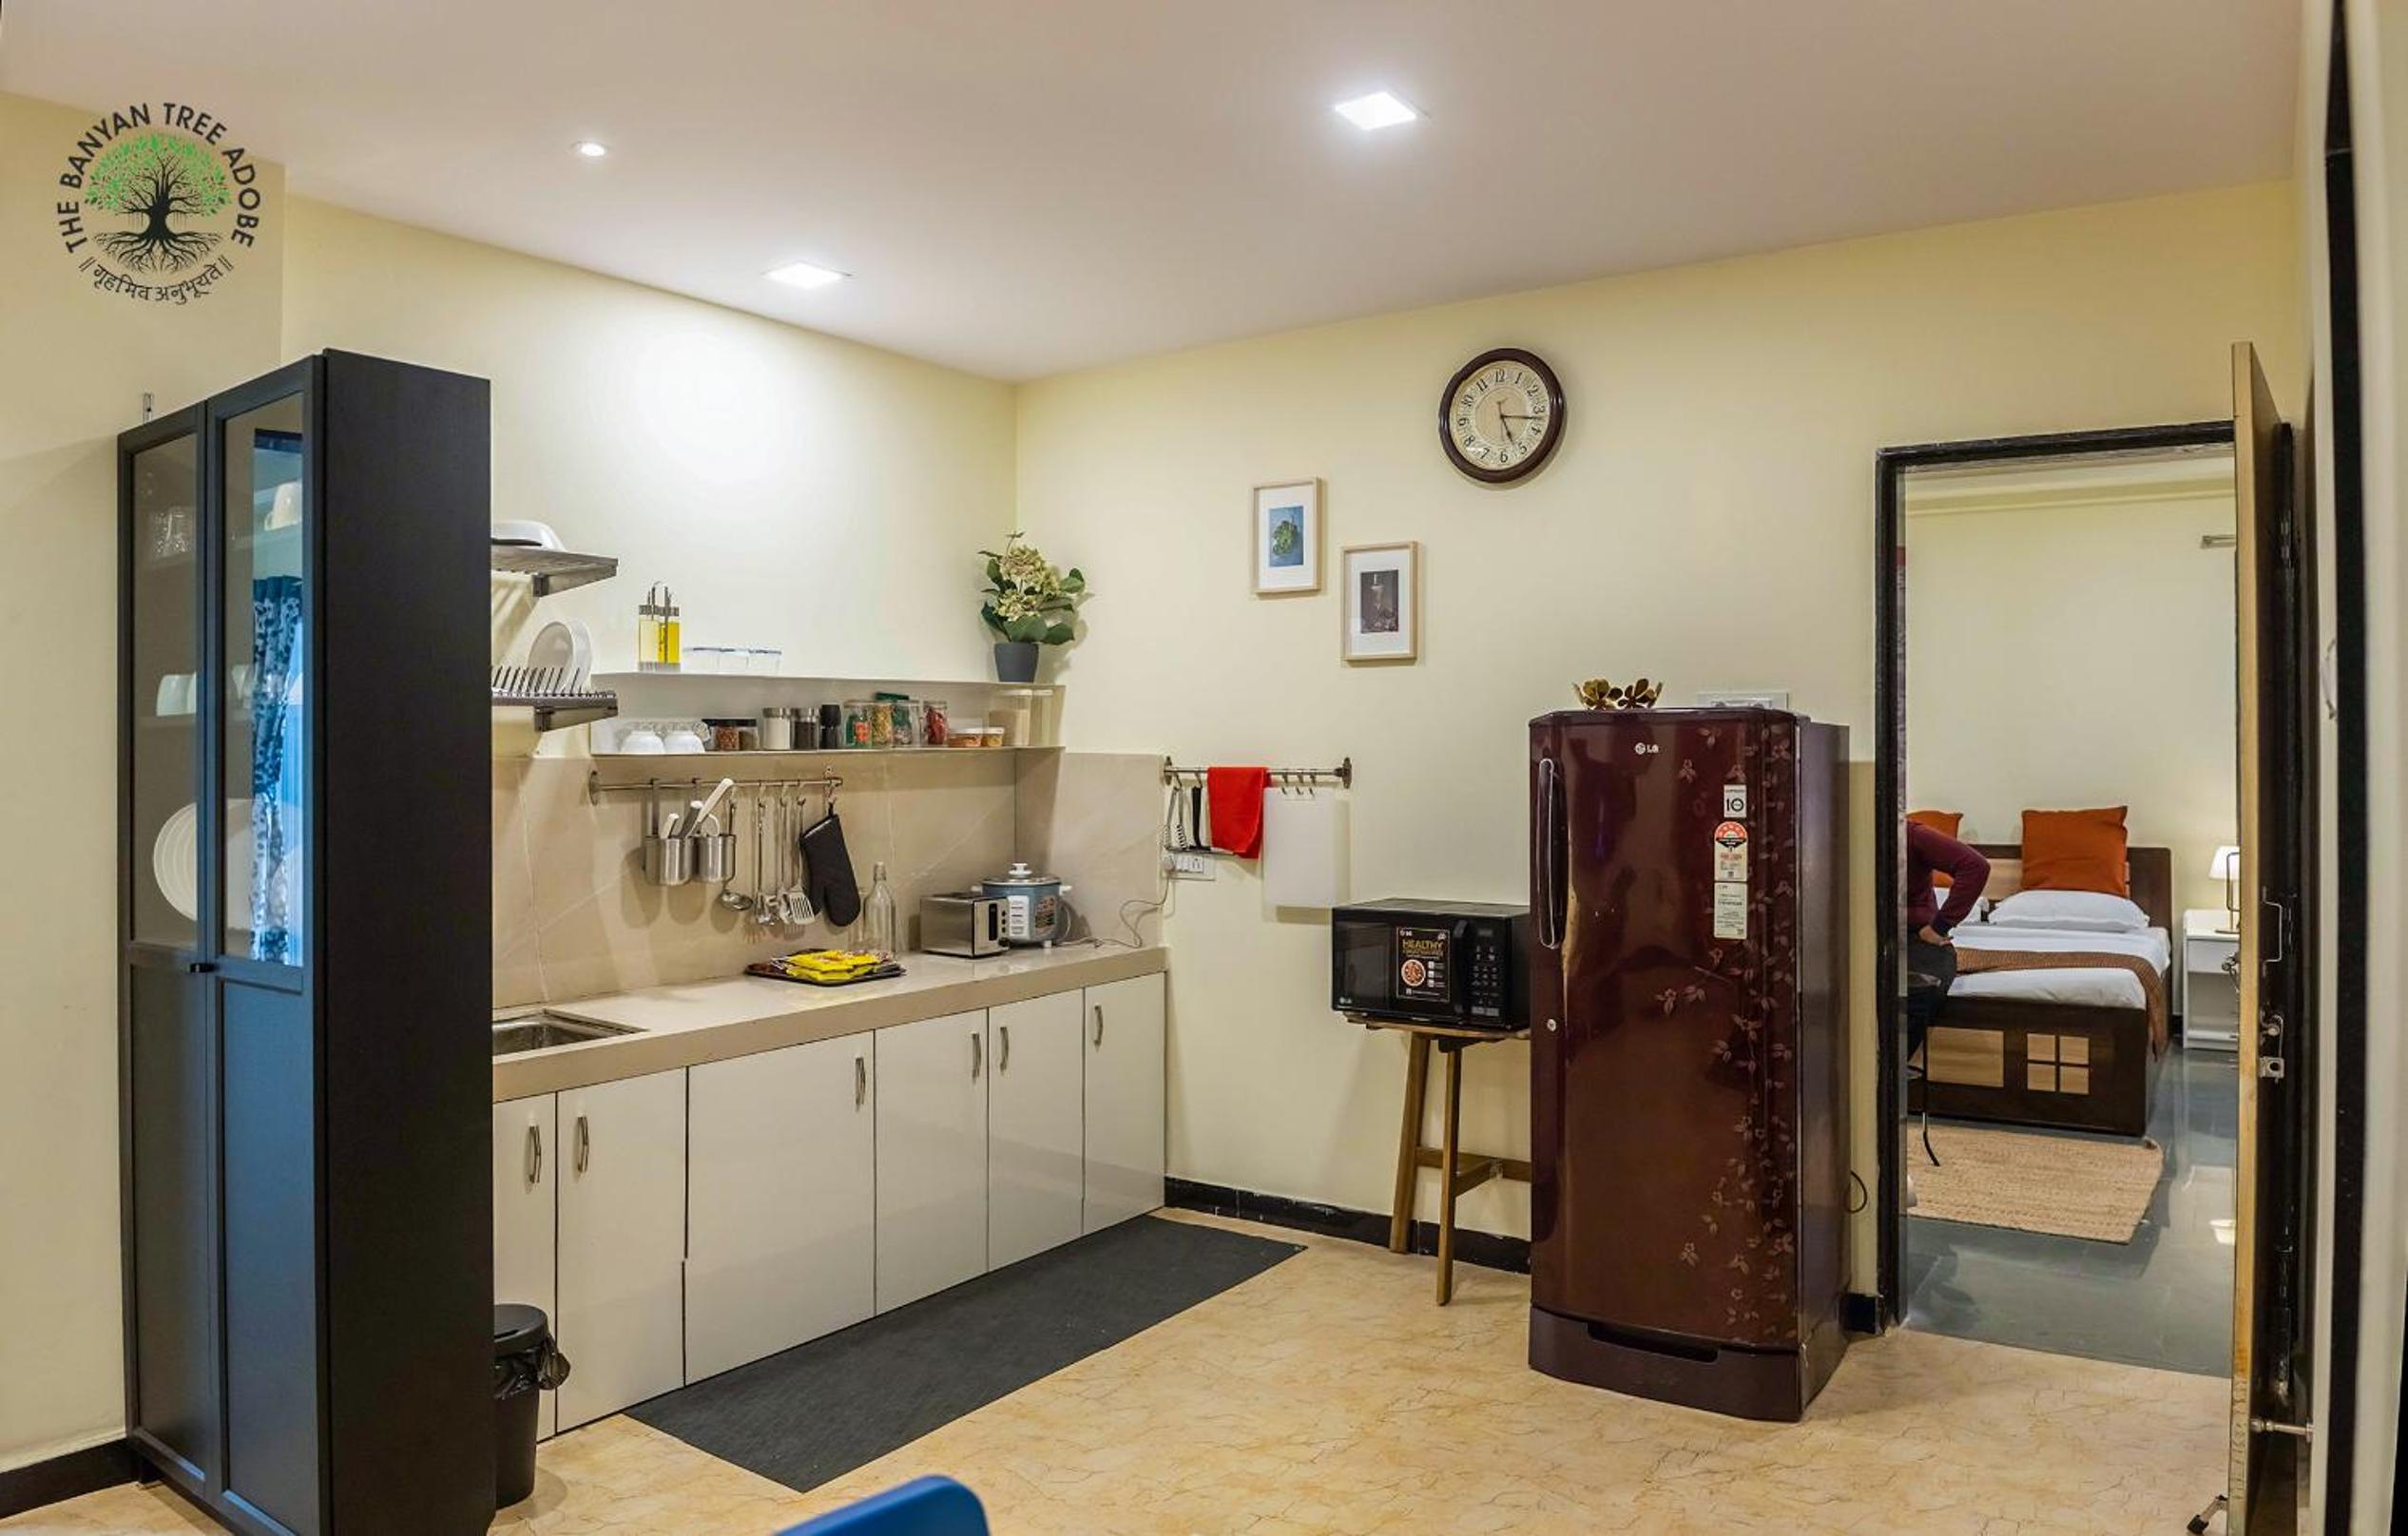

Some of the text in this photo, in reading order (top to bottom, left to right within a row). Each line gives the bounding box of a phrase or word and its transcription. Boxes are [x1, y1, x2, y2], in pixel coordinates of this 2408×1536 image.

[1494, 368, 1505, 382] 12
[1514, 372, 1522, 384] 1
[1527, 384, 1539, 396] 2
[1532, 405, 1546, 414] 3
[1531, 426, 1542, 435] 4
[1464, 434, 1475, 447] 8
[1480, 447, 1491, 459] 7
[1518, 442, 1528, 455] 5
[1500, 451, 1509, 463] 6
[1402, 939, 1444, 950] HEALTHY
